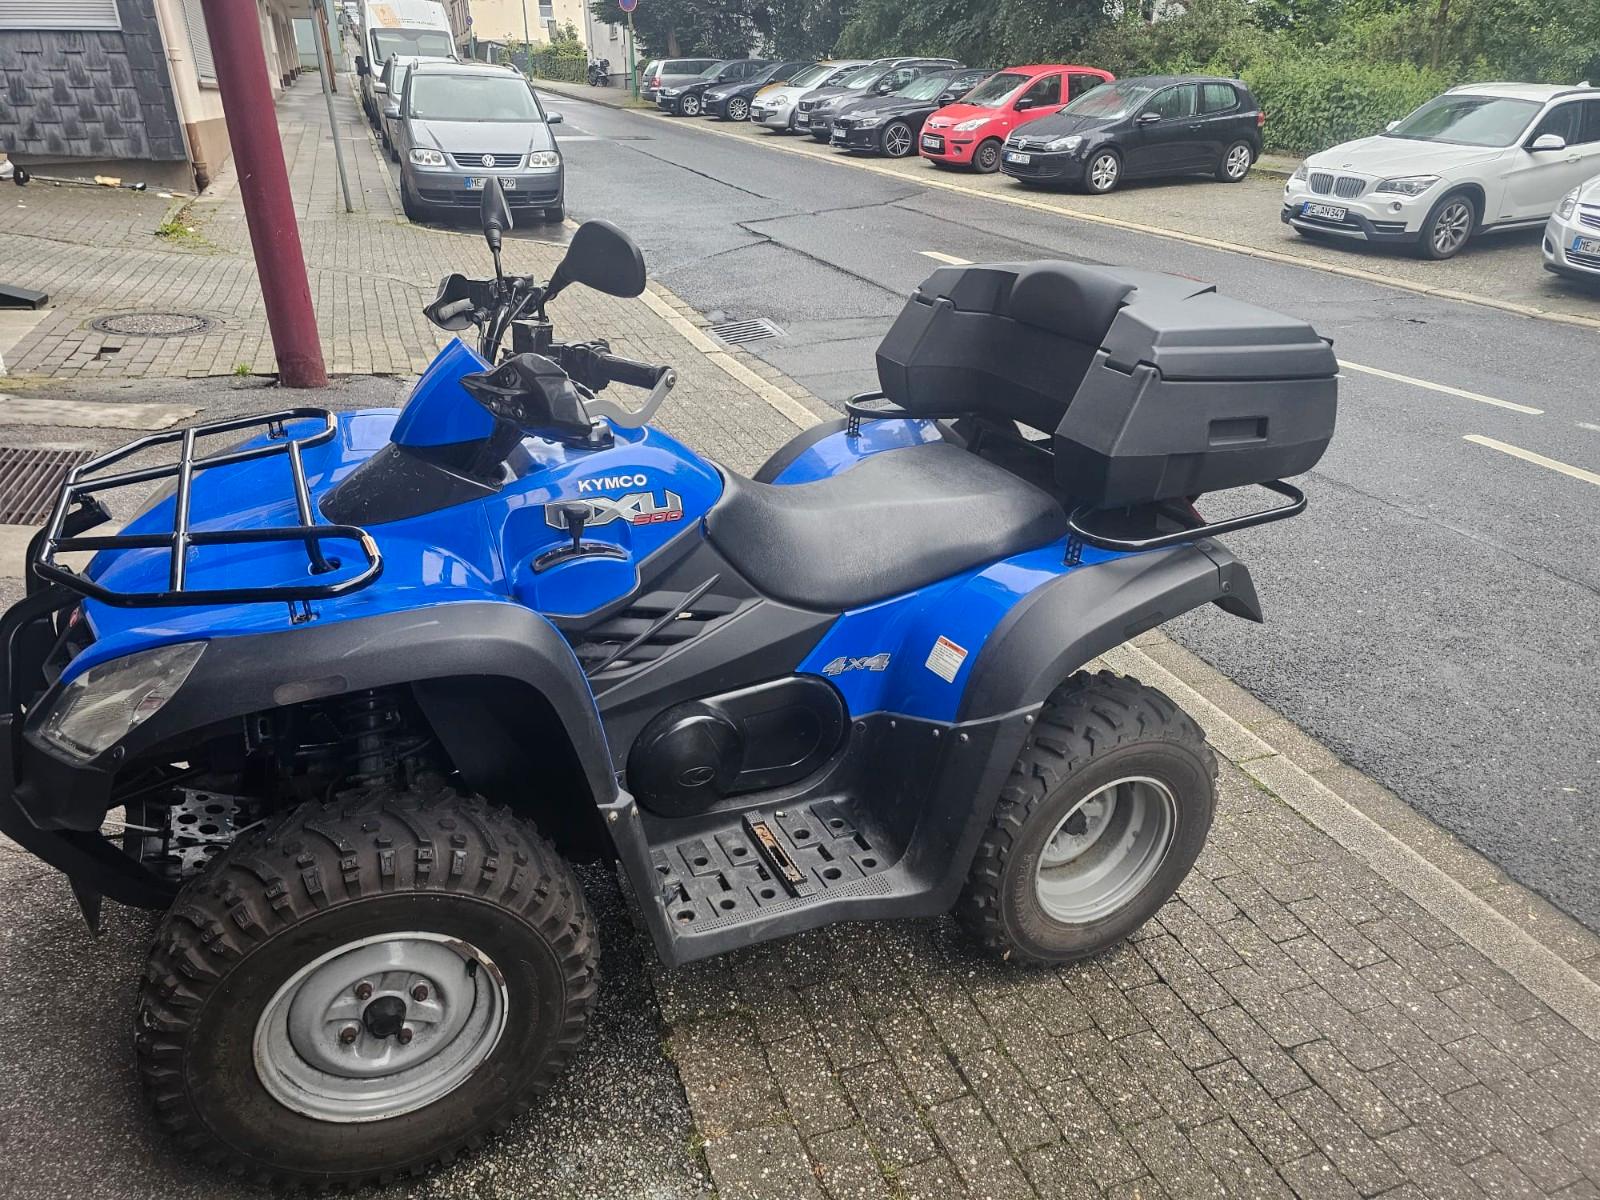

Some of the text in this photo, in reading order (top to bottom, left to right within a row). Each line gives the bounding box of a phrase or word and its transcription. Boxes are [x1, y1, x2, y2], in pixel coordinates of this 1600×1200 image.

[1306, 203, 1317, 214] ME
[1580, 239, 1592, 252] ME
[577, 473, 647, 493] KYMCO
[633, 509, 683, 526] 500
